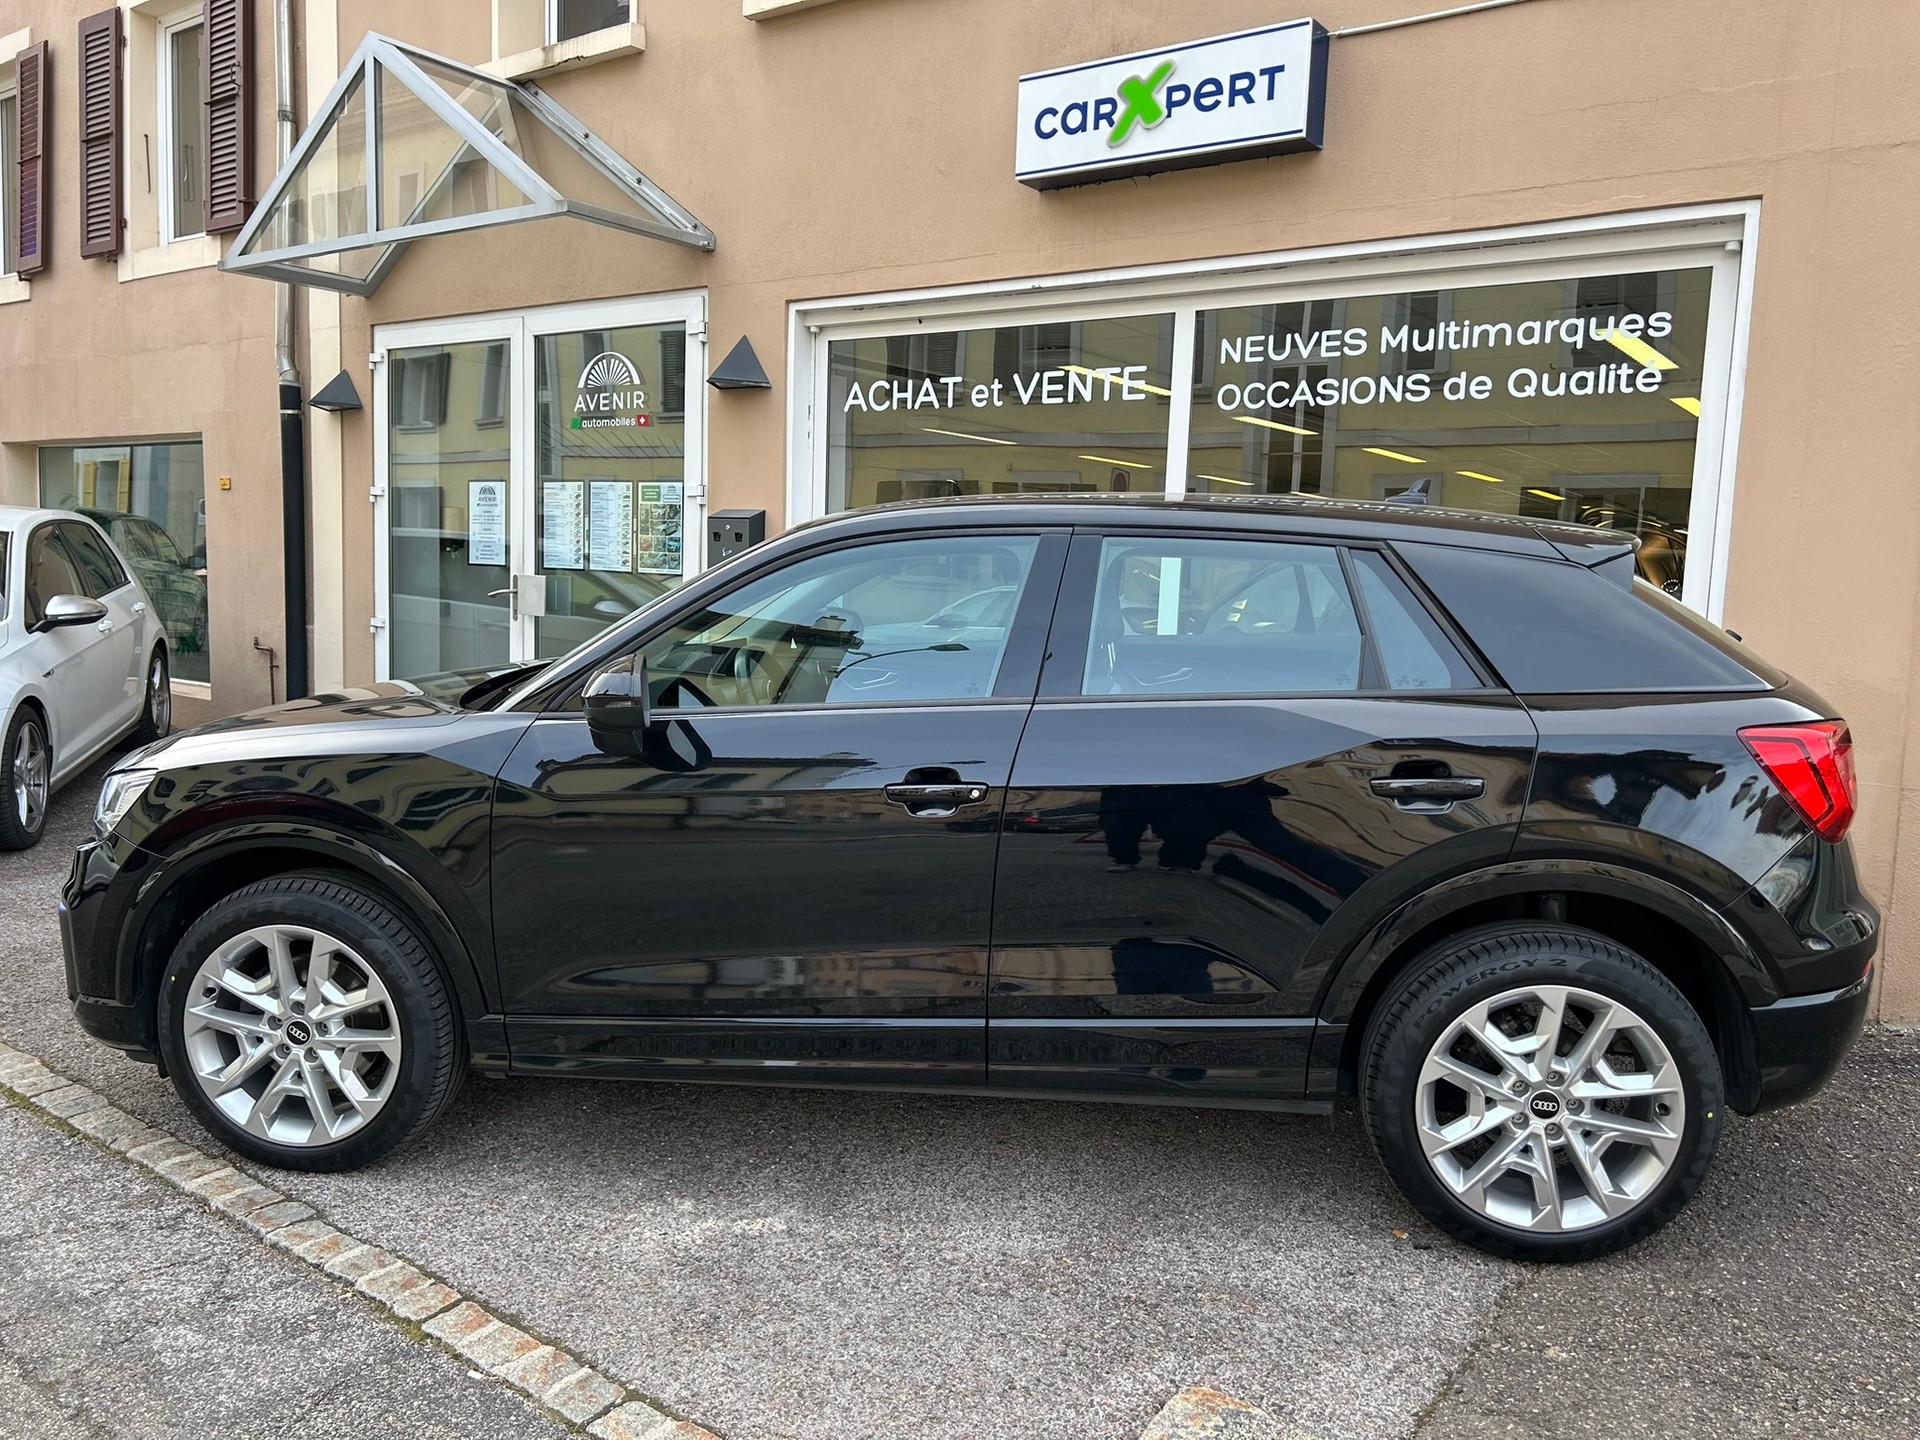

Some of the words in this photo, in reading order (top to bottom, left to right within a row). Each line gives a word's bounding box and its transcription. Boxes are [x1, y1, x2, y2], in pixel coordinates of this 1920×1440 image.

[1220, 327, 1368, 365] NEUVES
[1380, 311, 1673, 354] Multimarques
[574, 391, 645, 412] AVENIR
[843, 376, 964, 413] ACHAT
[970, 378, 1004, 408] et
[1013, 365, 1148, 406] VENTE
[1217, 373, 1431, 411] OCCASIONS
[1443, 371, 1493, 400] de
[1507, 360, 1663, 398] Qualité
[581, 417, 636, 428] automobiles
[1413, 958, 1538, 1030] POWERGY
